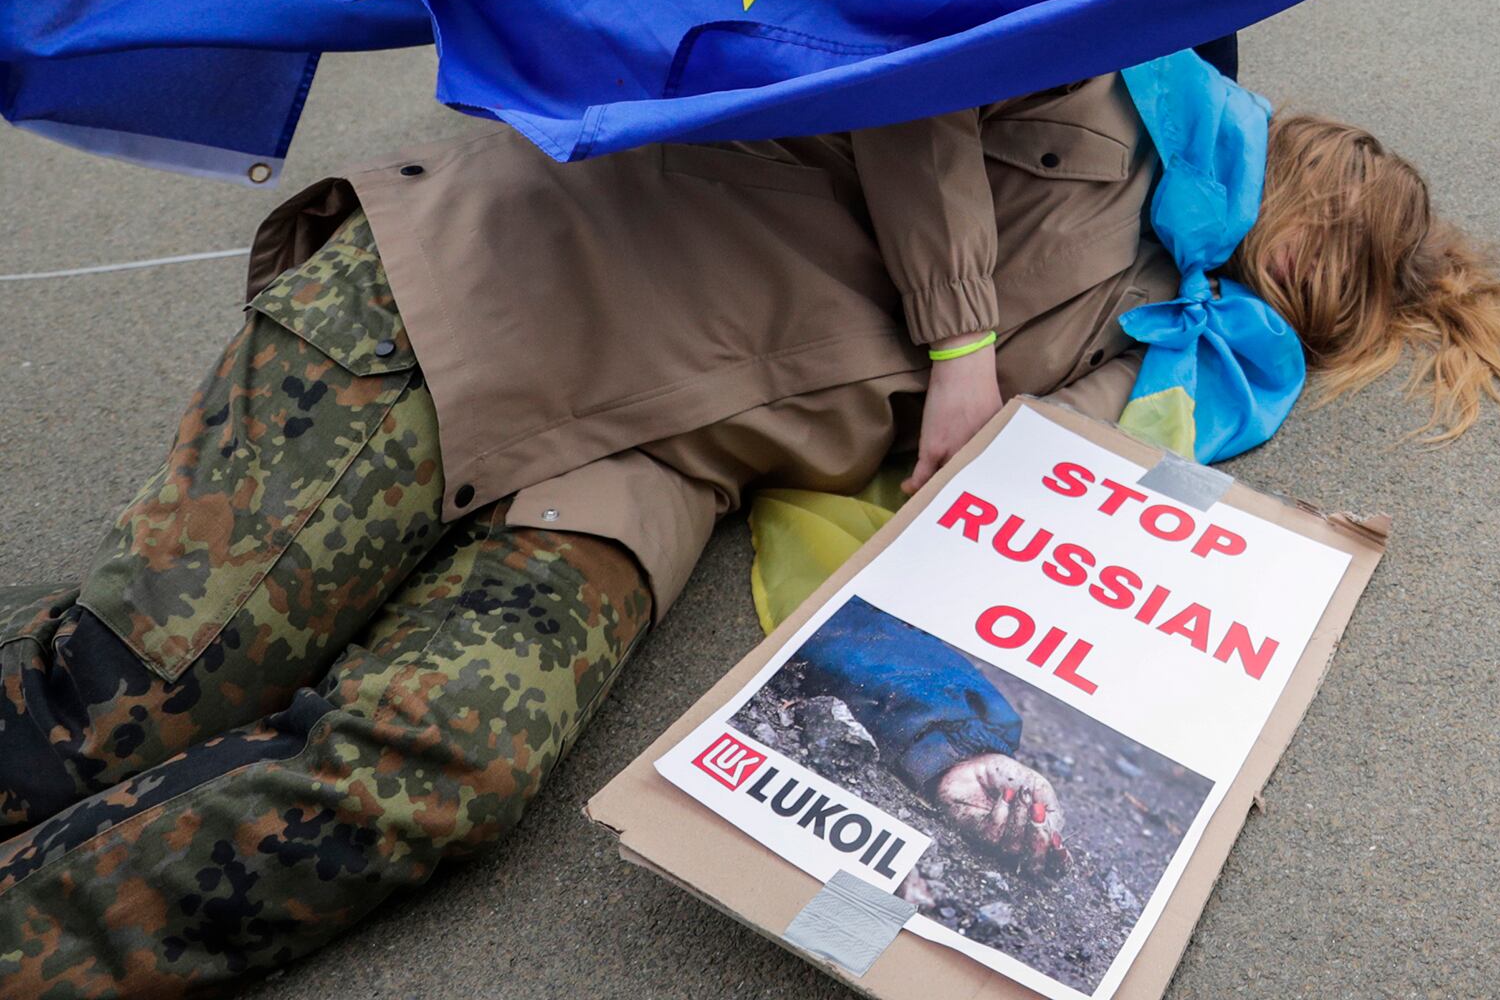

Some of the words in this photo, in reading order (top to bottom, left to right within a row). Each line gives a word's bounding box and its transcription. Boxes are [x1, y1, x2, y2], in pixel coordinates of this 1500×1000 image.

[1041, 461, 1248, 560] STOP
[936, 490, 1280, 681] RUSSIAN
[974, 604, 1099, 696] OIL
[745, 766, 907, 881] LUKOIL
